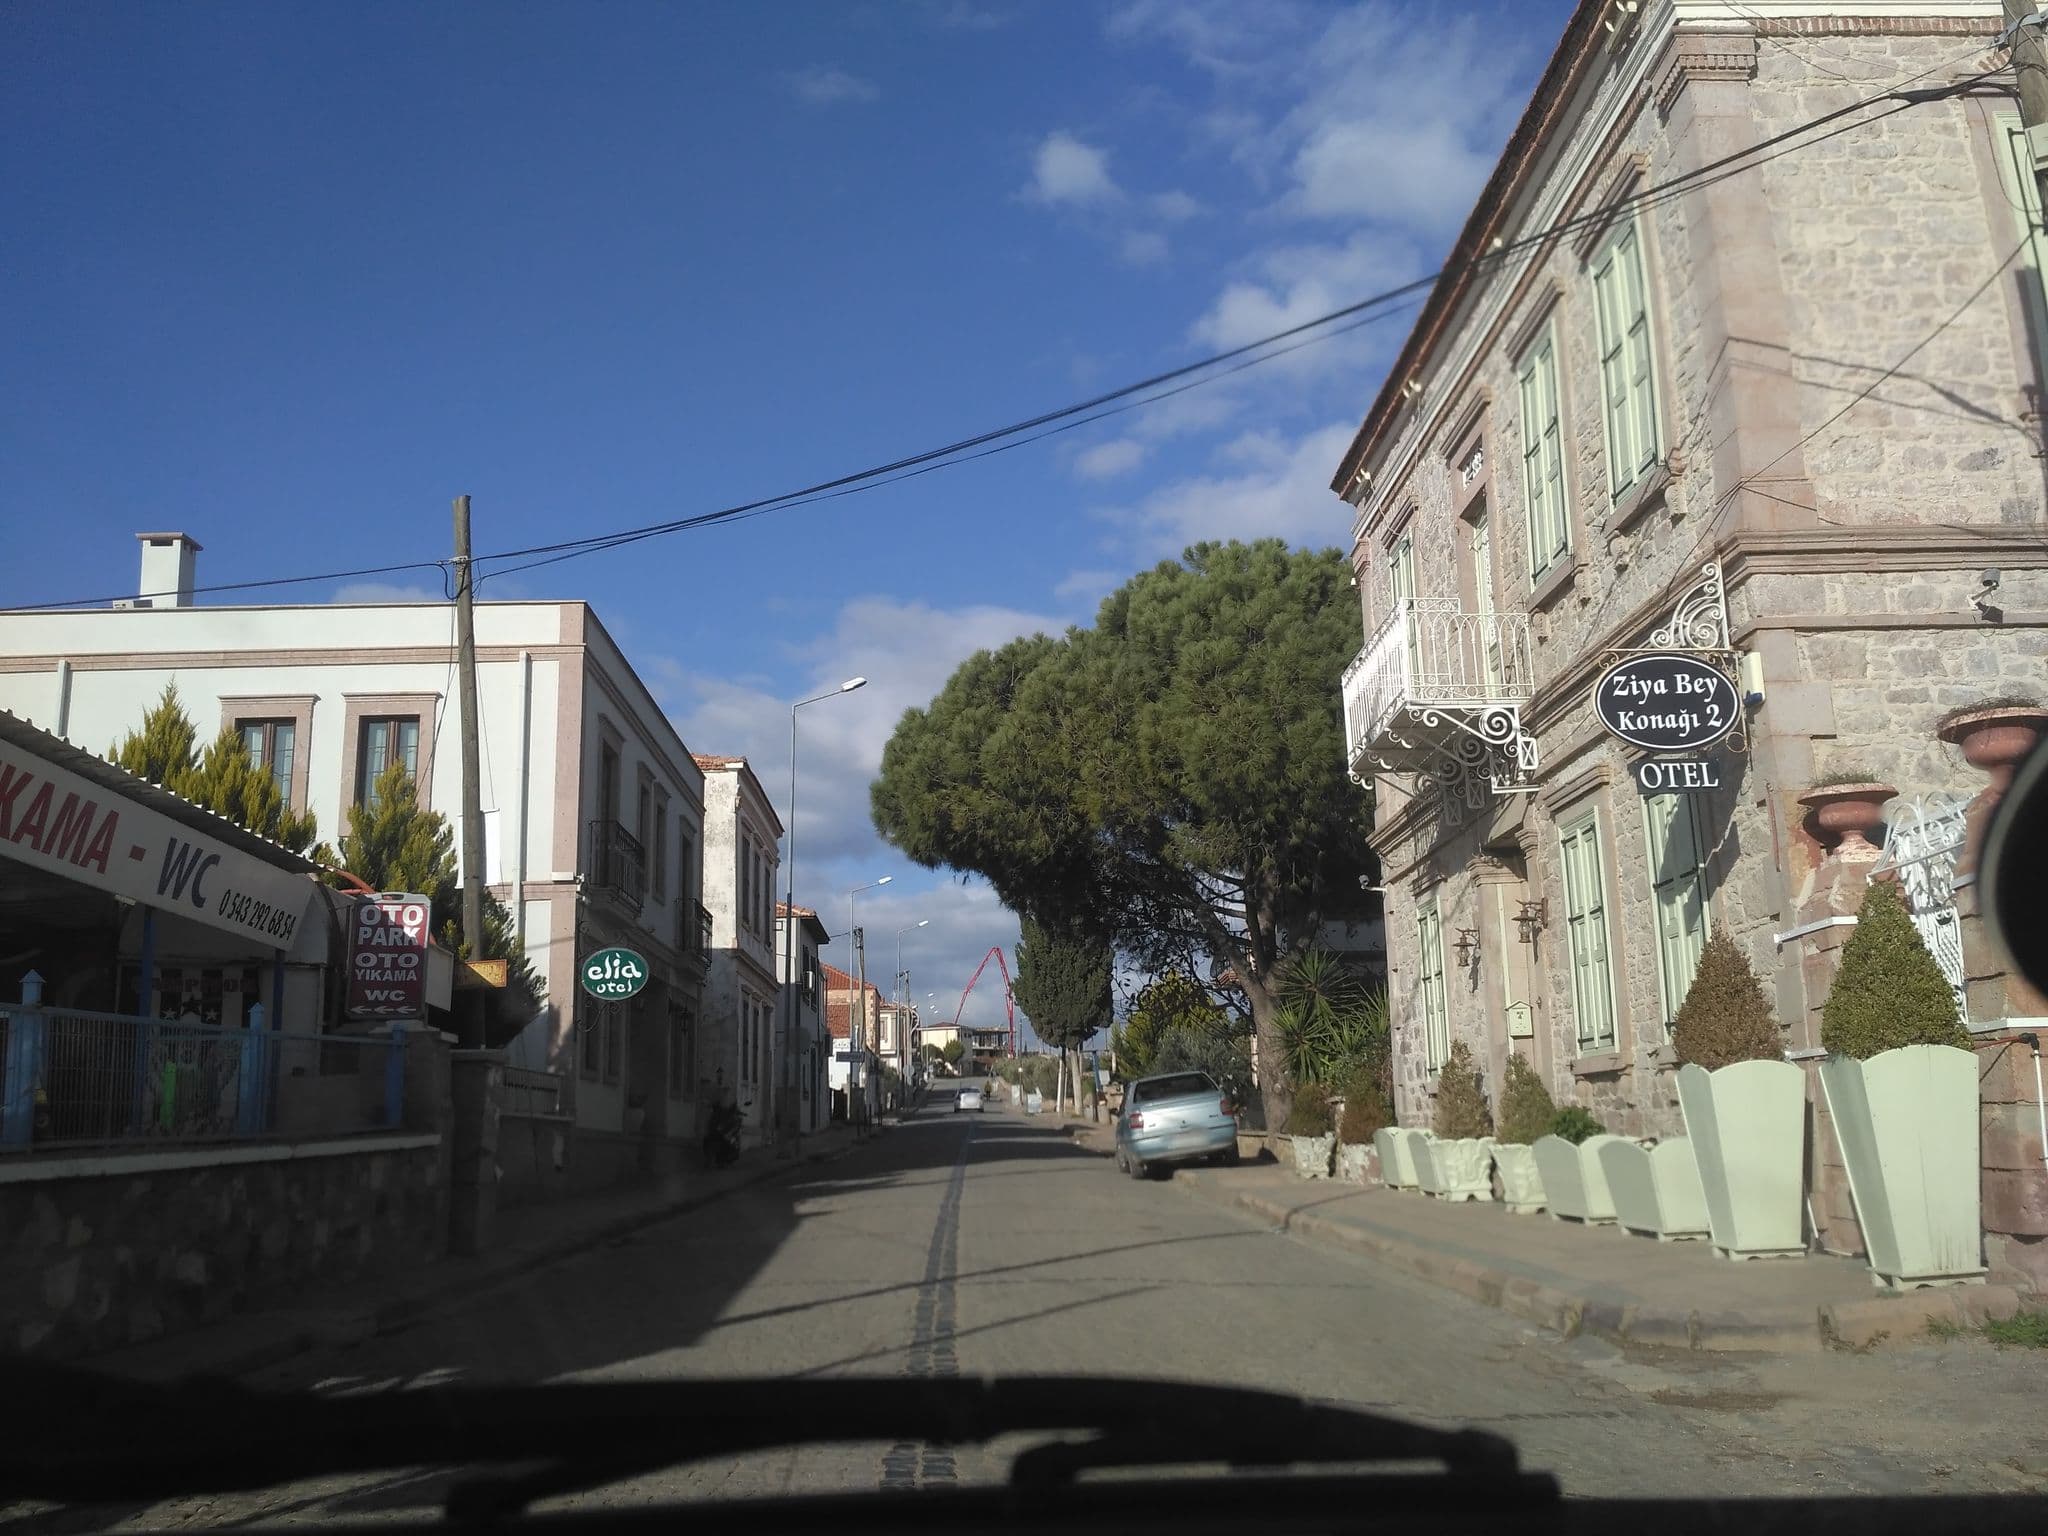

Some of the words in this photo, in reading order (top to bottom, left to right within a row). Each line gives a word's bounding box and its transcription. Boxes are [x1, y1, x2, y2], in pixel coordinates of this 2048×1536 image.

[1613, 674, 1669, 705] Ziya
[1674, 673, 1718, 702] Bey
[1617, 709, 1701, 737] Konağı
[1706, 704, 1723, 728] 2
[1640, 762, 1719, 789] OTEL
[0, 760, 119, 875] KAMA
[157, 837, 221, 909] WC
[360, 905, 423, 926] OTO
[358, 926, 421, 946] PARK
[355, 953, 419, 968] OTO
[588, 952, 642, 980] elia
[355, 969, 417, 981] YIKAMA
[364, 990, 406, 1001] WC
